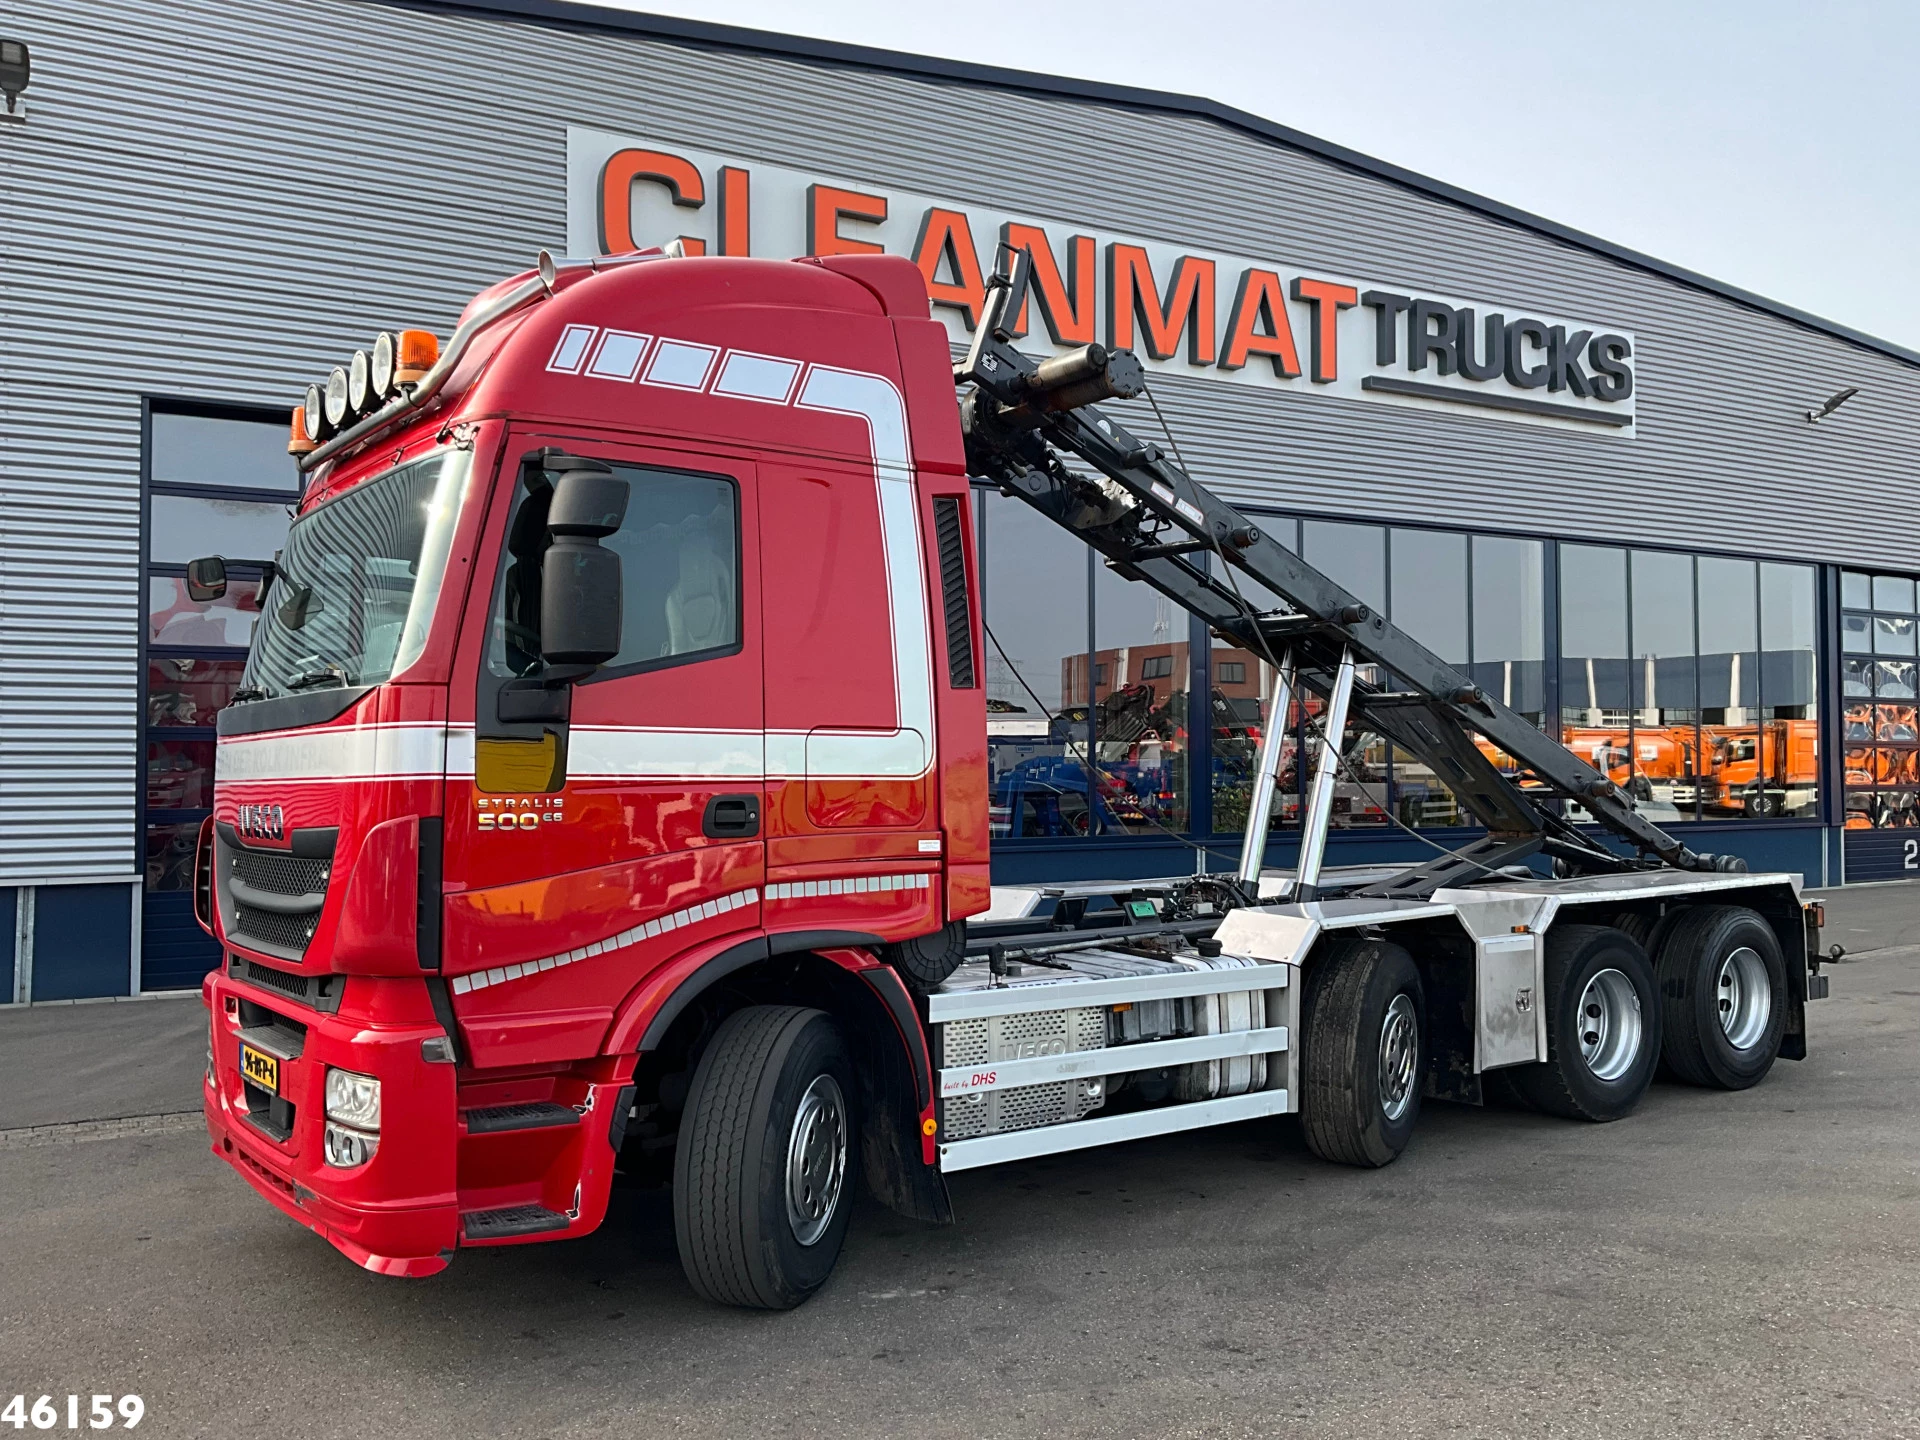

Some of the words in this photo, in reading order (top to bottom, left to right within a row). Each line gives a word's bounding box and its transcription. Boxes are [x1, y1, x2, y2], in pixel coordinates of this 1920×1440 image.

[1361, 290, 1633, 401] TRUCKS
[478, 799, 563, 808] STRALIS
[239, 804, 284, 841] IVECO
[478, 813, 539, 831] 500
[1904, 839, 1918, 869] 2
[999, 1038, 1066, 1061] IVECO
[943, 1081, 959, 1091] built
[961, 1080, 969, 1089] by
[971, 1071, 997, 1087] DHS
